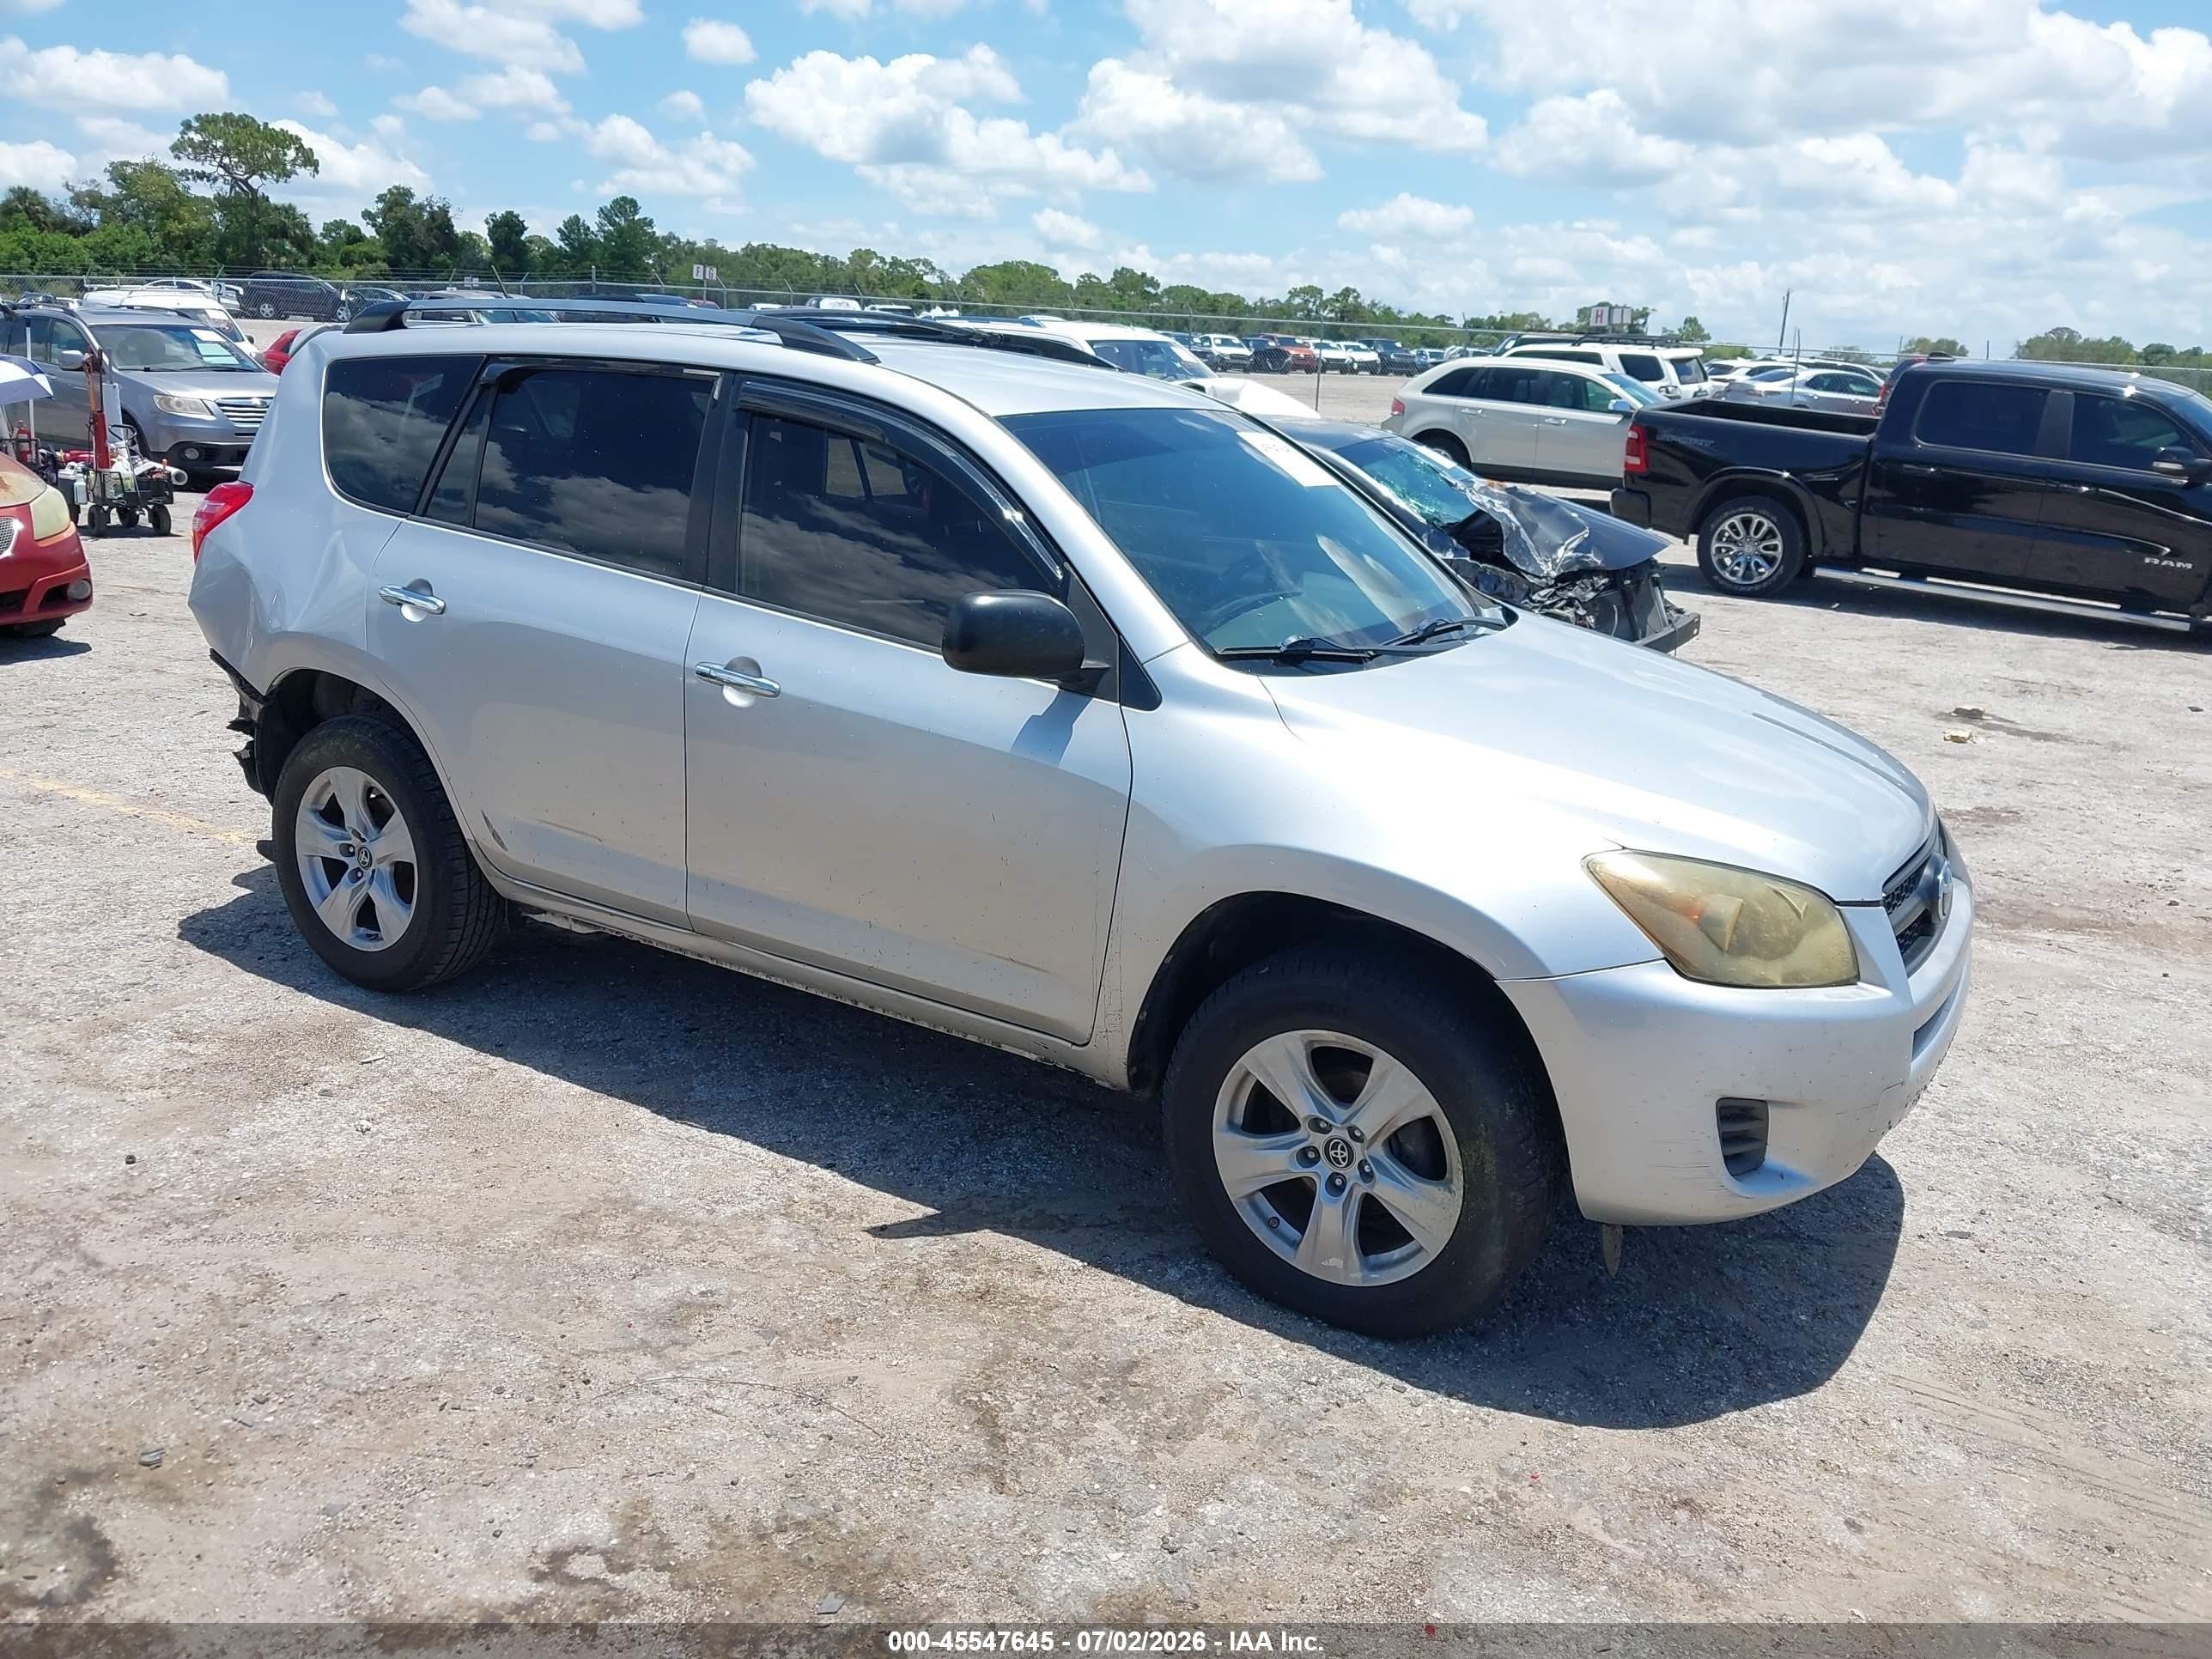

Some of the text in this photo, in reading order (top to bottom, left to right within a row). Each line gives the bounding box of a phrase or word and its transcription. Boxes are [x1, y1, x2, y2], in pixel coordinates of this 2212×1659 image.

[216, 283, 223, 296] 2
[1595, 308, 1603, 324] H
[2144, 556, 2193, 569] RAM
